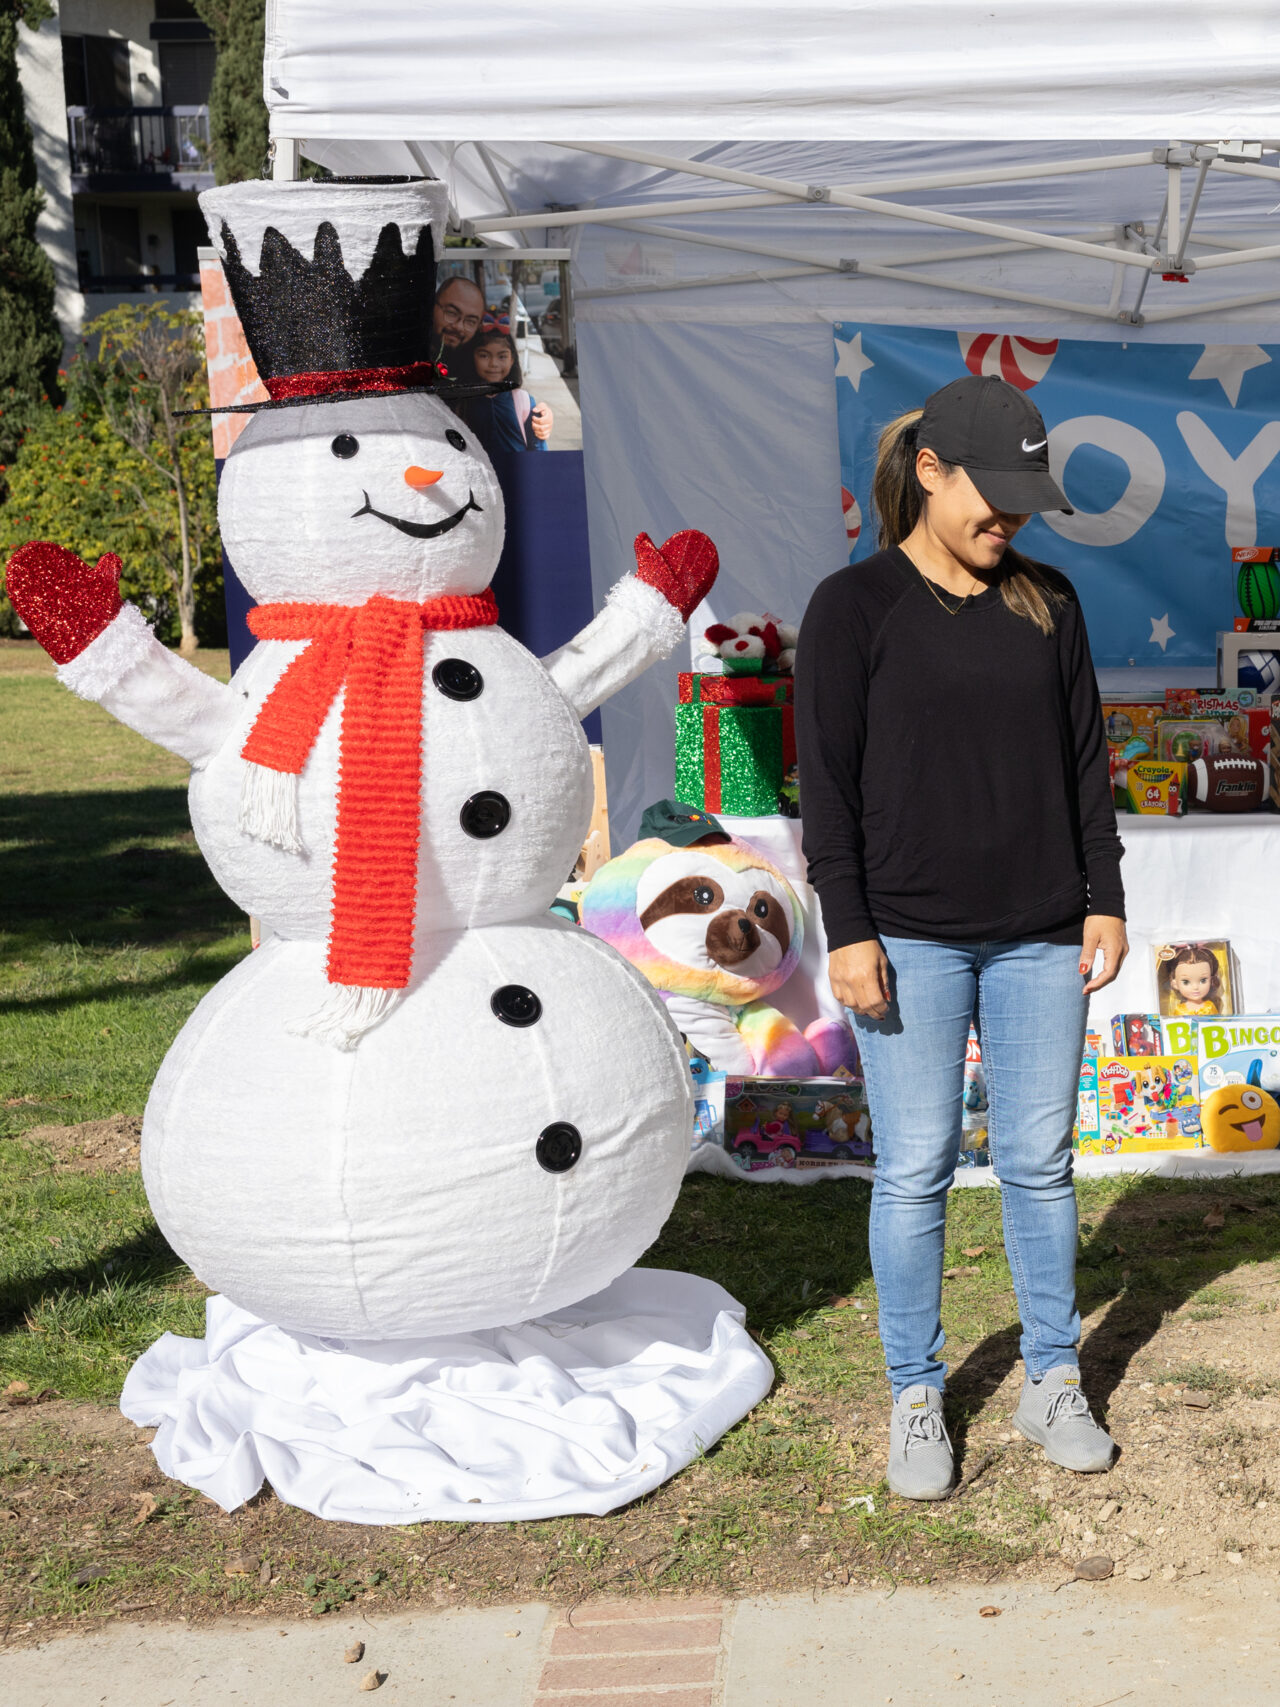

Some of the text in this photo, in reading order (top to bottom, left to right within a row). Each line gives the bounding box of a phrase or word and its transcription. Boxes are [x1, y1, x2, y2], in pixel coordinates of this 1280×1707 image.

[1137, 765, 1171, 775] Crayola
[1146, 788, 1160, 799] 64
[1140, 799, 1168, 809] CRAYONS
[1100, 1064, 1129, 1078] Play-Doh
[1209, 1066, 1218, 1075] 75
